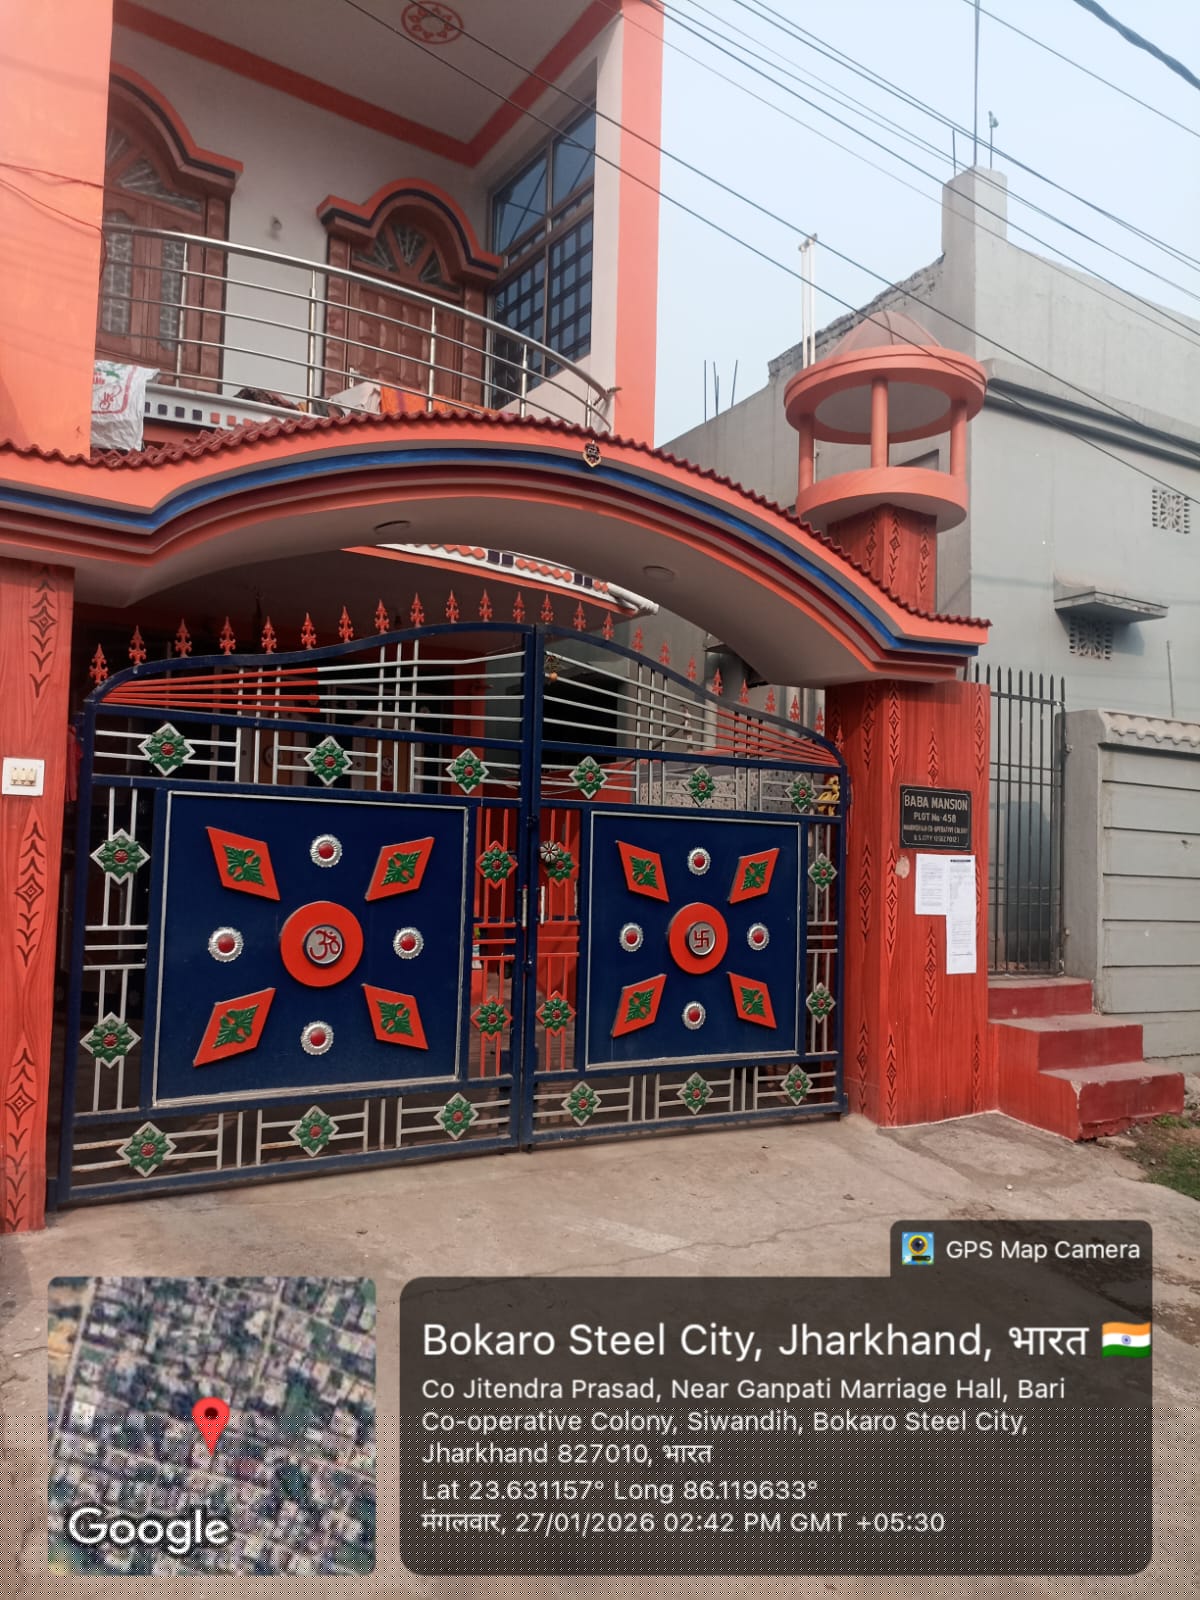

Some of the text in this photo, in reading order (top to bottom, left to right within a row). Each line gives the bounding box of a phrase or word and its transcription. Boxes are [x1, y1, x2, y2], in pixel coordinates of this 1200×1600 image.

[904, 795, 968, 811] BABA MANSION
[913, 811, 930, 822] PLOT
